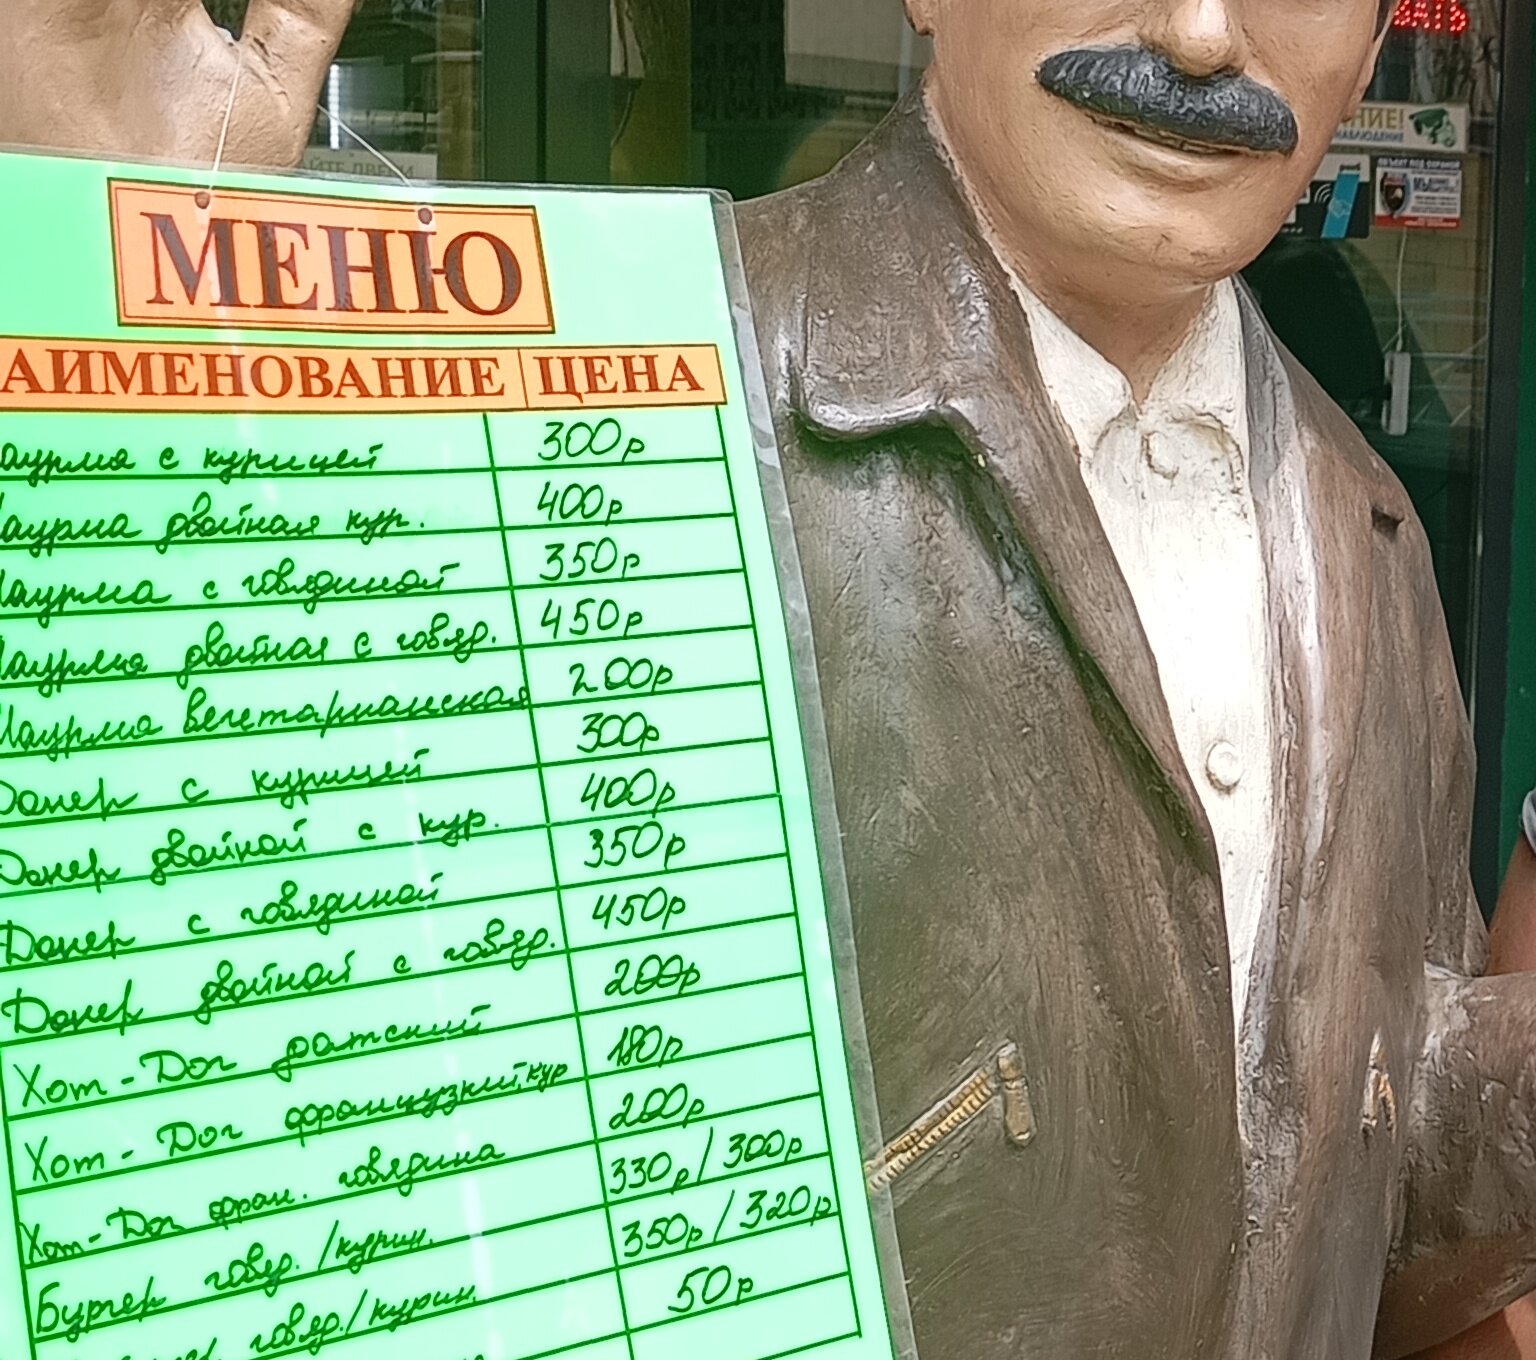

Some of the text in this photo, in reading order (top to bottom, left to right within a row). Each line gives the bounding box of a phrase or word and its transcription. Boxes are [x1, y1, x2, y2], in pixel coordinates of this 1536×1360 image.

[140, 211, 523, 316] МЕНЮ
[0, 348, 705, 403] АИМЕНОВАНИЕ ЦЕНА
[0, 442, 137, 487] аурма
[538, 418, 645, 463] 300р
[0, 492, 143, 558] аурма
[537, 481, 622, 526] 400р
[0, 569, 172, 628] аурма
[539, 537, 640, 581] 350р
[0, 635, 148, 698] аурма
[541, 598, 643, 639] 450р
[569, 657, 673, 696] 200р
[577, 712, 660, 755] 300р
[580, 768, 676, 818] 400р
[584, 820, 686, 871] 350р
[592, 886, 686, 930] 450р
[668, 1266, 754, 1314] 50р
